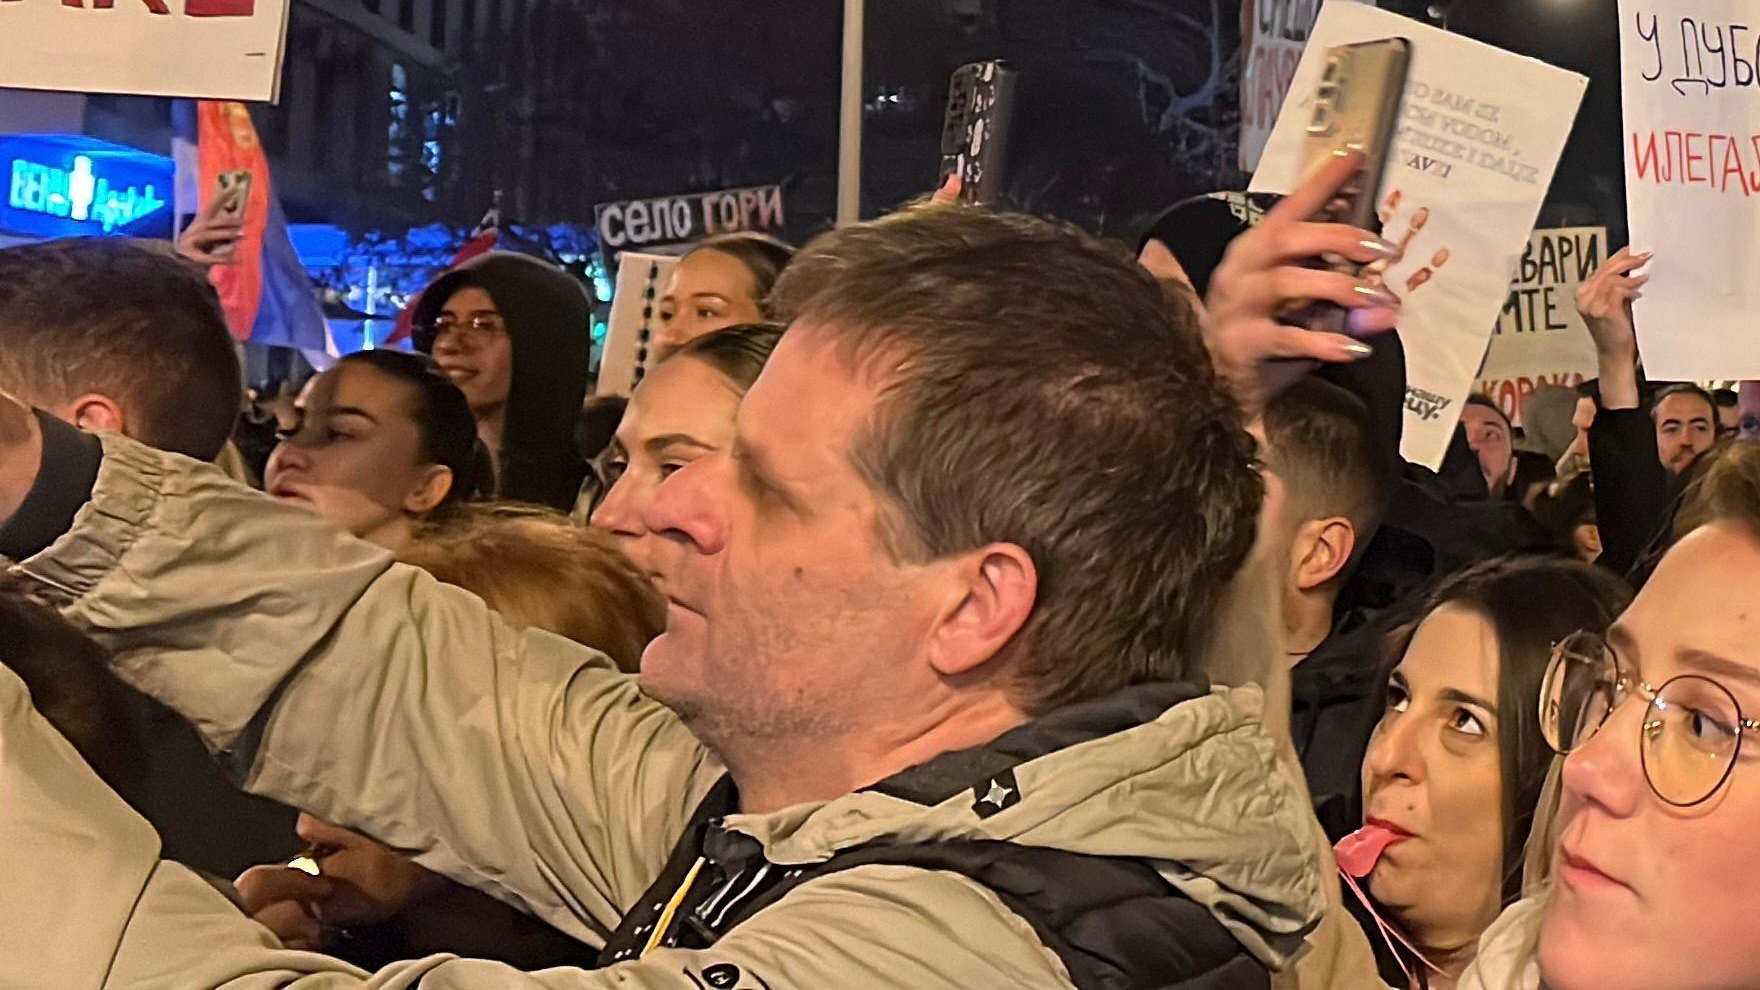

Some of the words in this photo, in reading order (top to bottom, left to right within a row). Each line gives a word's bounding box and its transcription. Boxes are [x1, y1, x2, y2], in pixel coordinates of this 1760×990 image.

[1635, 12, 1663, 82] У
[702, 185, 785, 235] ГОРИ
[1512, 234, 1598, 285] ВАРИ
[1495, 287, 1568, 335] МТЕ
